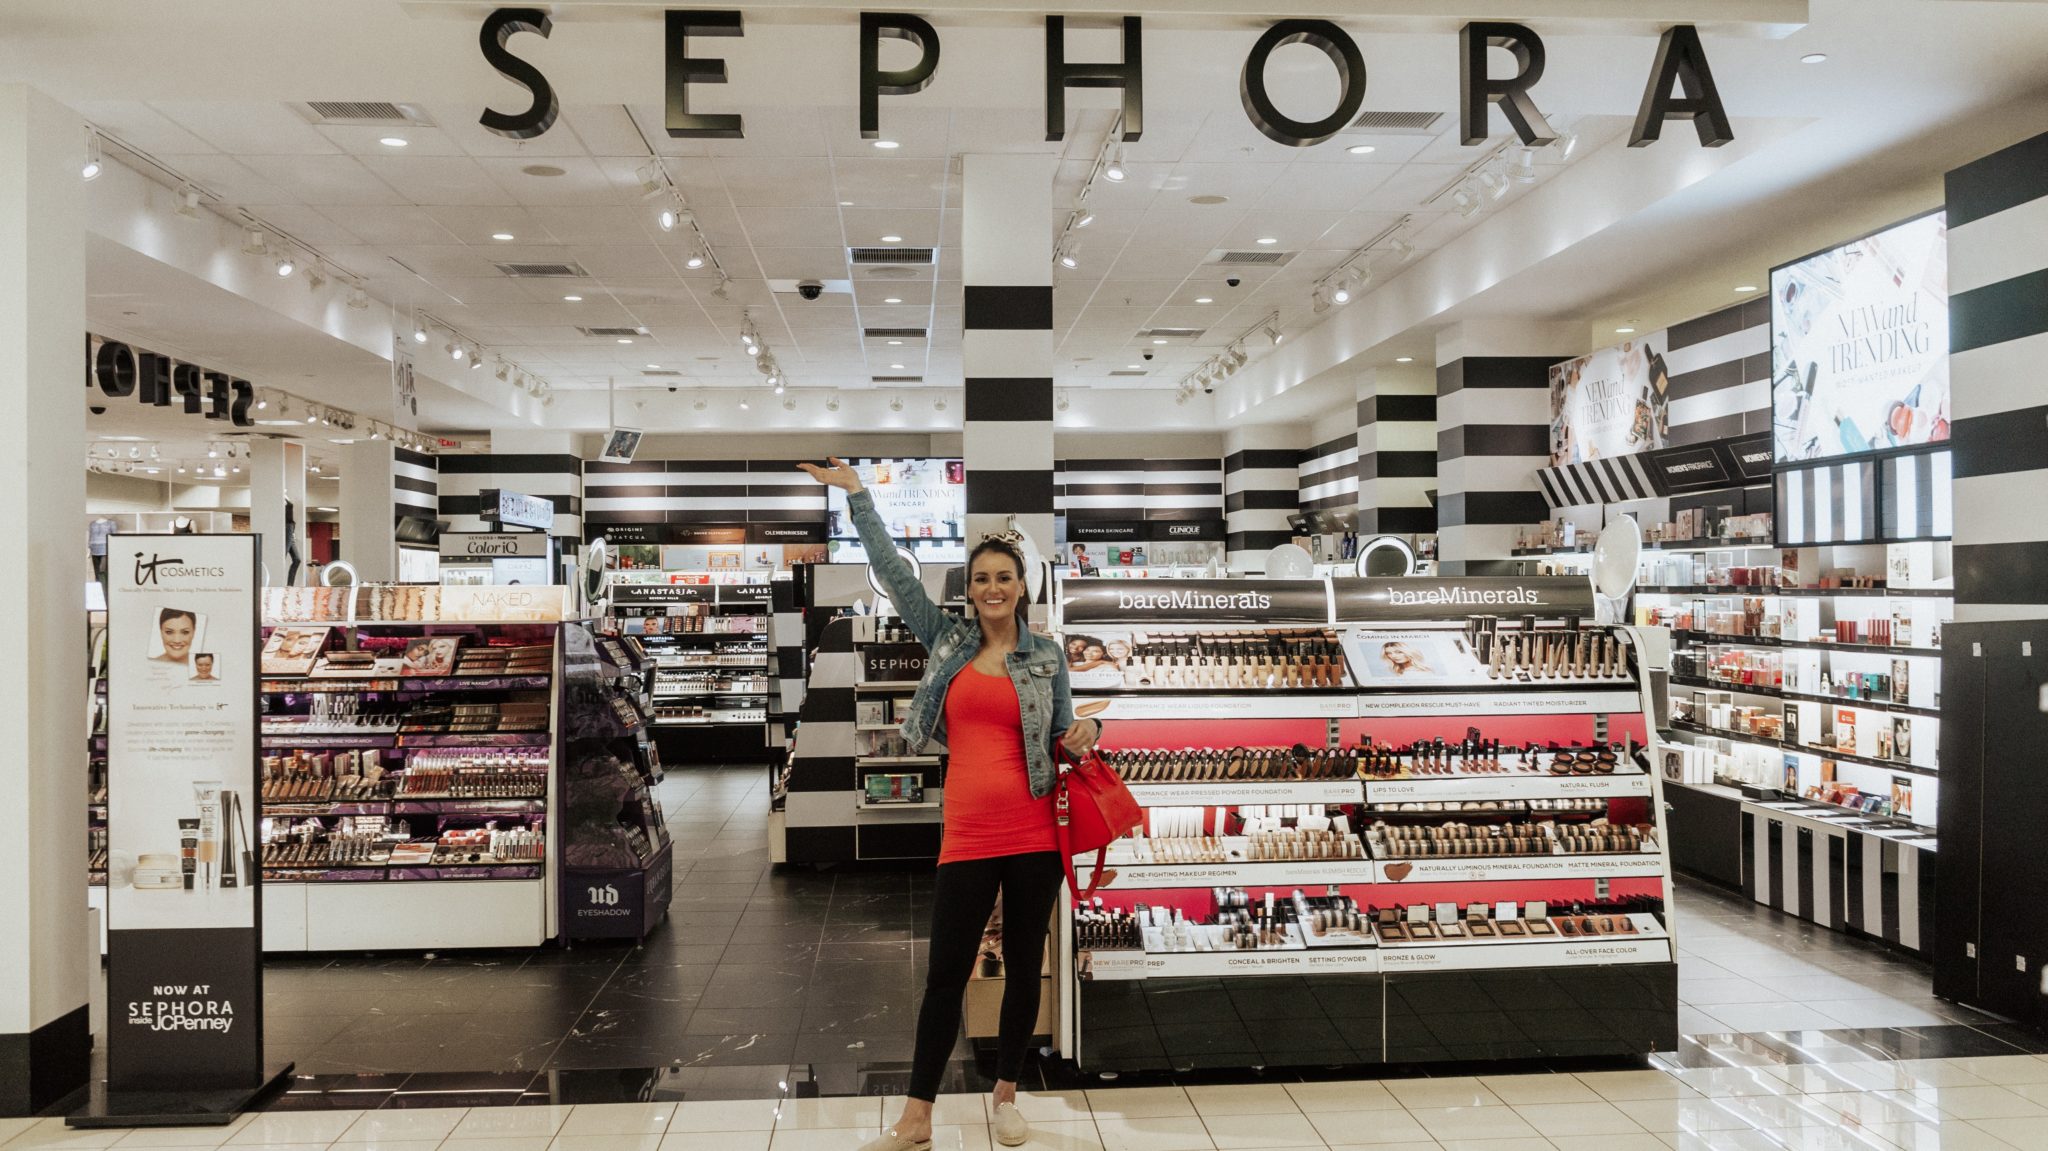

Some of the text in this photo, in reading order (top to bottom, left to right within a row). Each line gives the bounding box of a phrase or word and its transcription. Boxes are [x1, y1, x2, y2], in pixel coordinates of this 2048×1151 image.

[479, 7, 1734, 147] SEPHORA
[1829, 321, 1929, 374] TRENDING
[1169, 525, 1200, 535] CLINIQUE
[467, 541, 502, 554] Color
[160, 567, 225, 577] COSMETICS
[472, 592, 532, 606] NAKED
[1119, 590, 1270, 609] bareMinerals
[1387, 586, 1538, 605] bareMinerals
[1250, 788, 1293, 796] FOUNDATION
[577, 909, 631, 917] EYESHADOW
[153, 984, 211, 996] NOW AT
[128, 1000, 234, 1017] SEPHORA
[128, 1014, 233, 1034] inside JCPenney
